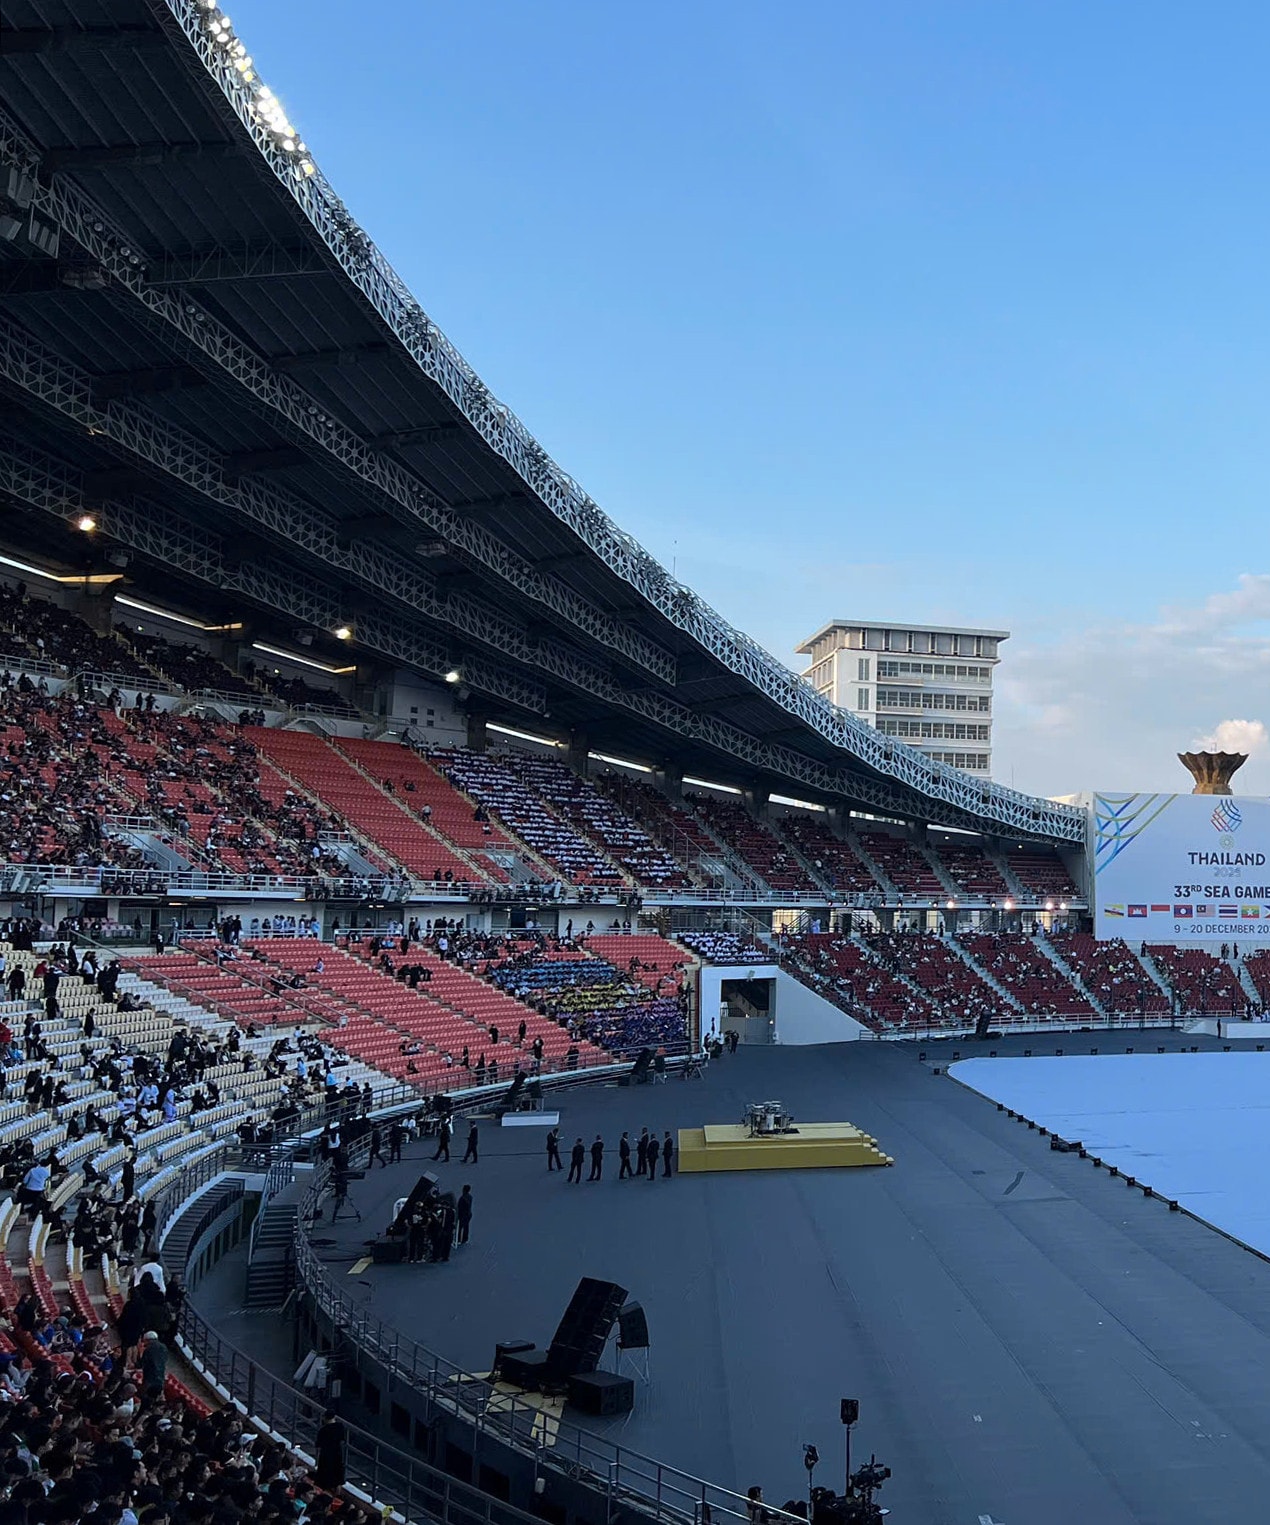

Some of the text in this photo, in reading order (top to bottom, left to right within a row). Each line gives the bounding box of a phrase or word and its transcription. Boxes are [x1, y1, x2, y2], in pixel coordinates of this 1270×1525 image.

[1188, 852, 1266, 866] THAILAND
[1213, 867, 1242, 877] 2025
[1174, 885, 1202, 898] 33RD
[1204, 886, 1231, 898] SEA
[1174, 924, 1181, 933] 9
[1190, 924, 1203, 933] 20
[1205, 924, 1255, 933] DECEMBER
